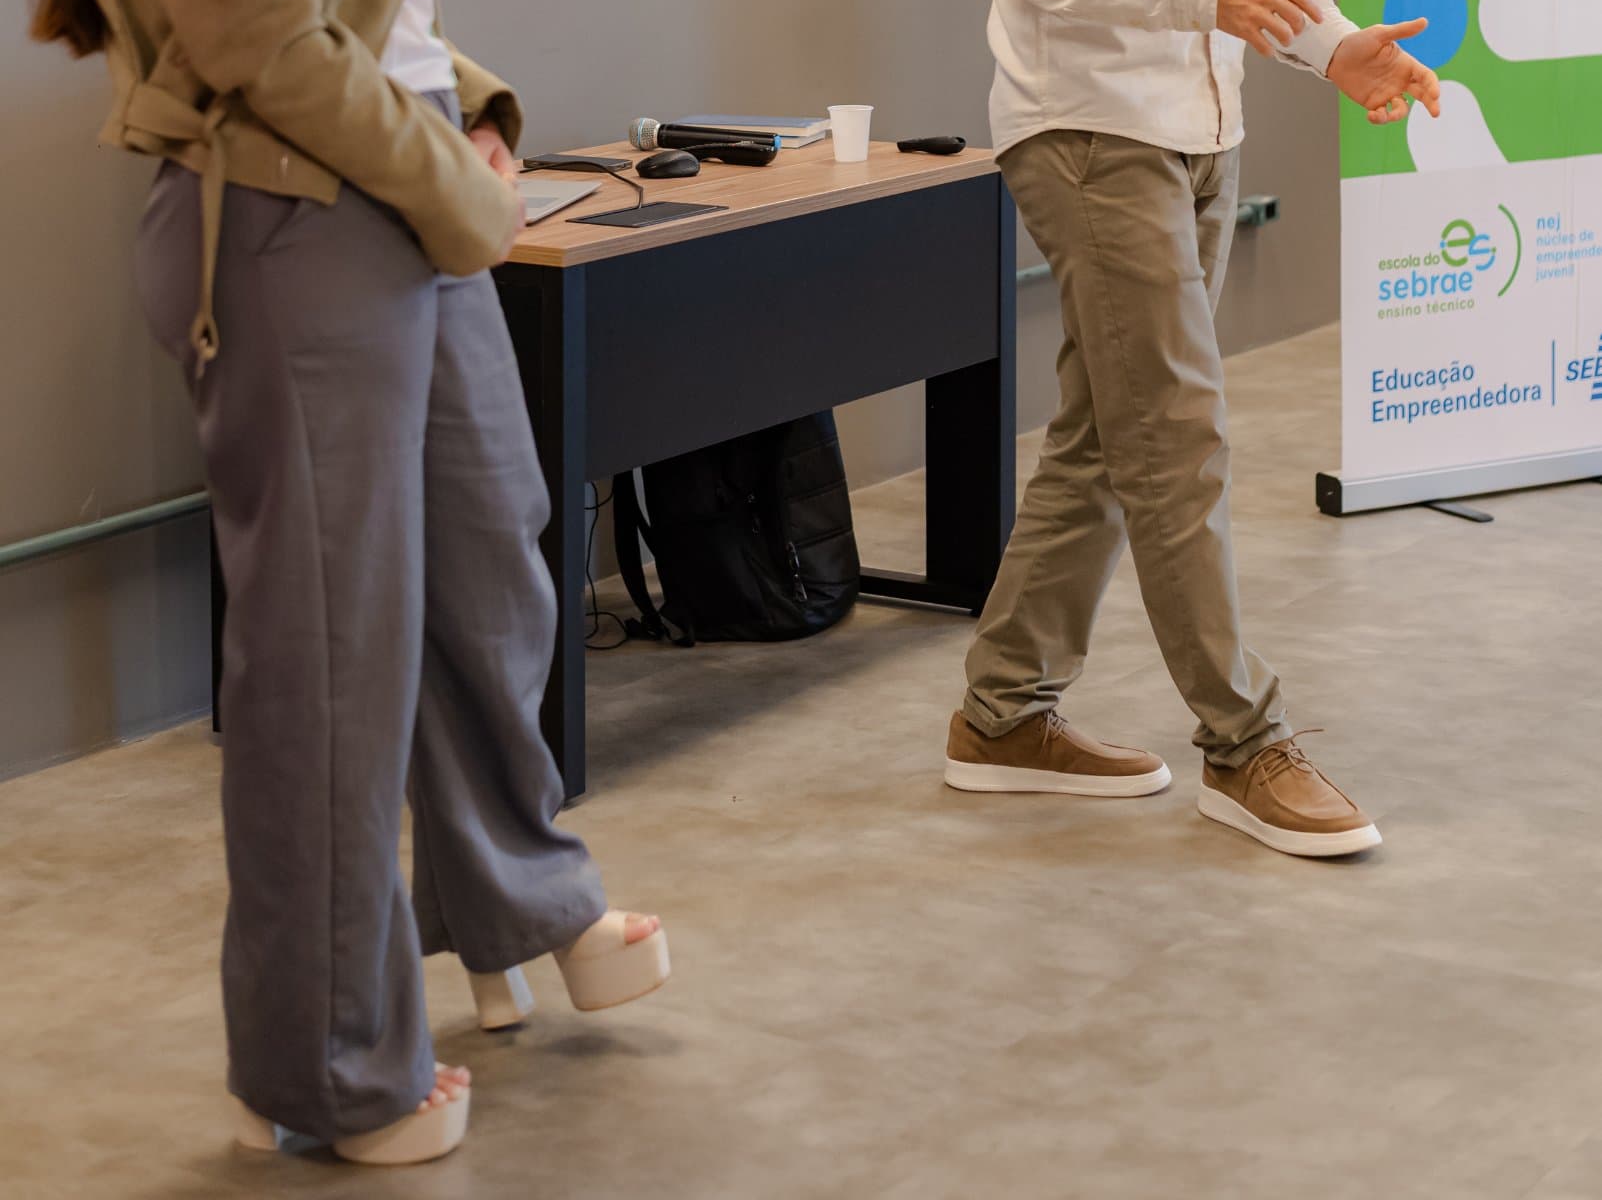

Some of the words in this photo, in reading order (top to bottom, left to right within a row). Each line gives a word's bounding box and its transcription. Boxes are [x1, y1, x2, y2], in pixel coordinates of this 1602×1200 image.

[1536, 212, 1561, 232] nej
[1579, 228, 1594, 242] de
[1378, 254, 1421, 271] escola
[1423, 252, 1441, 266] do
[1378, 270, 1473, 301] sebrae
[1377, 304, 1422, 320] ensino
[1426, 297, 1475, 315] técnico
[1371, 361, 1475, 393] Educação
[1371, 383, 1542, 424] Empreendedora
